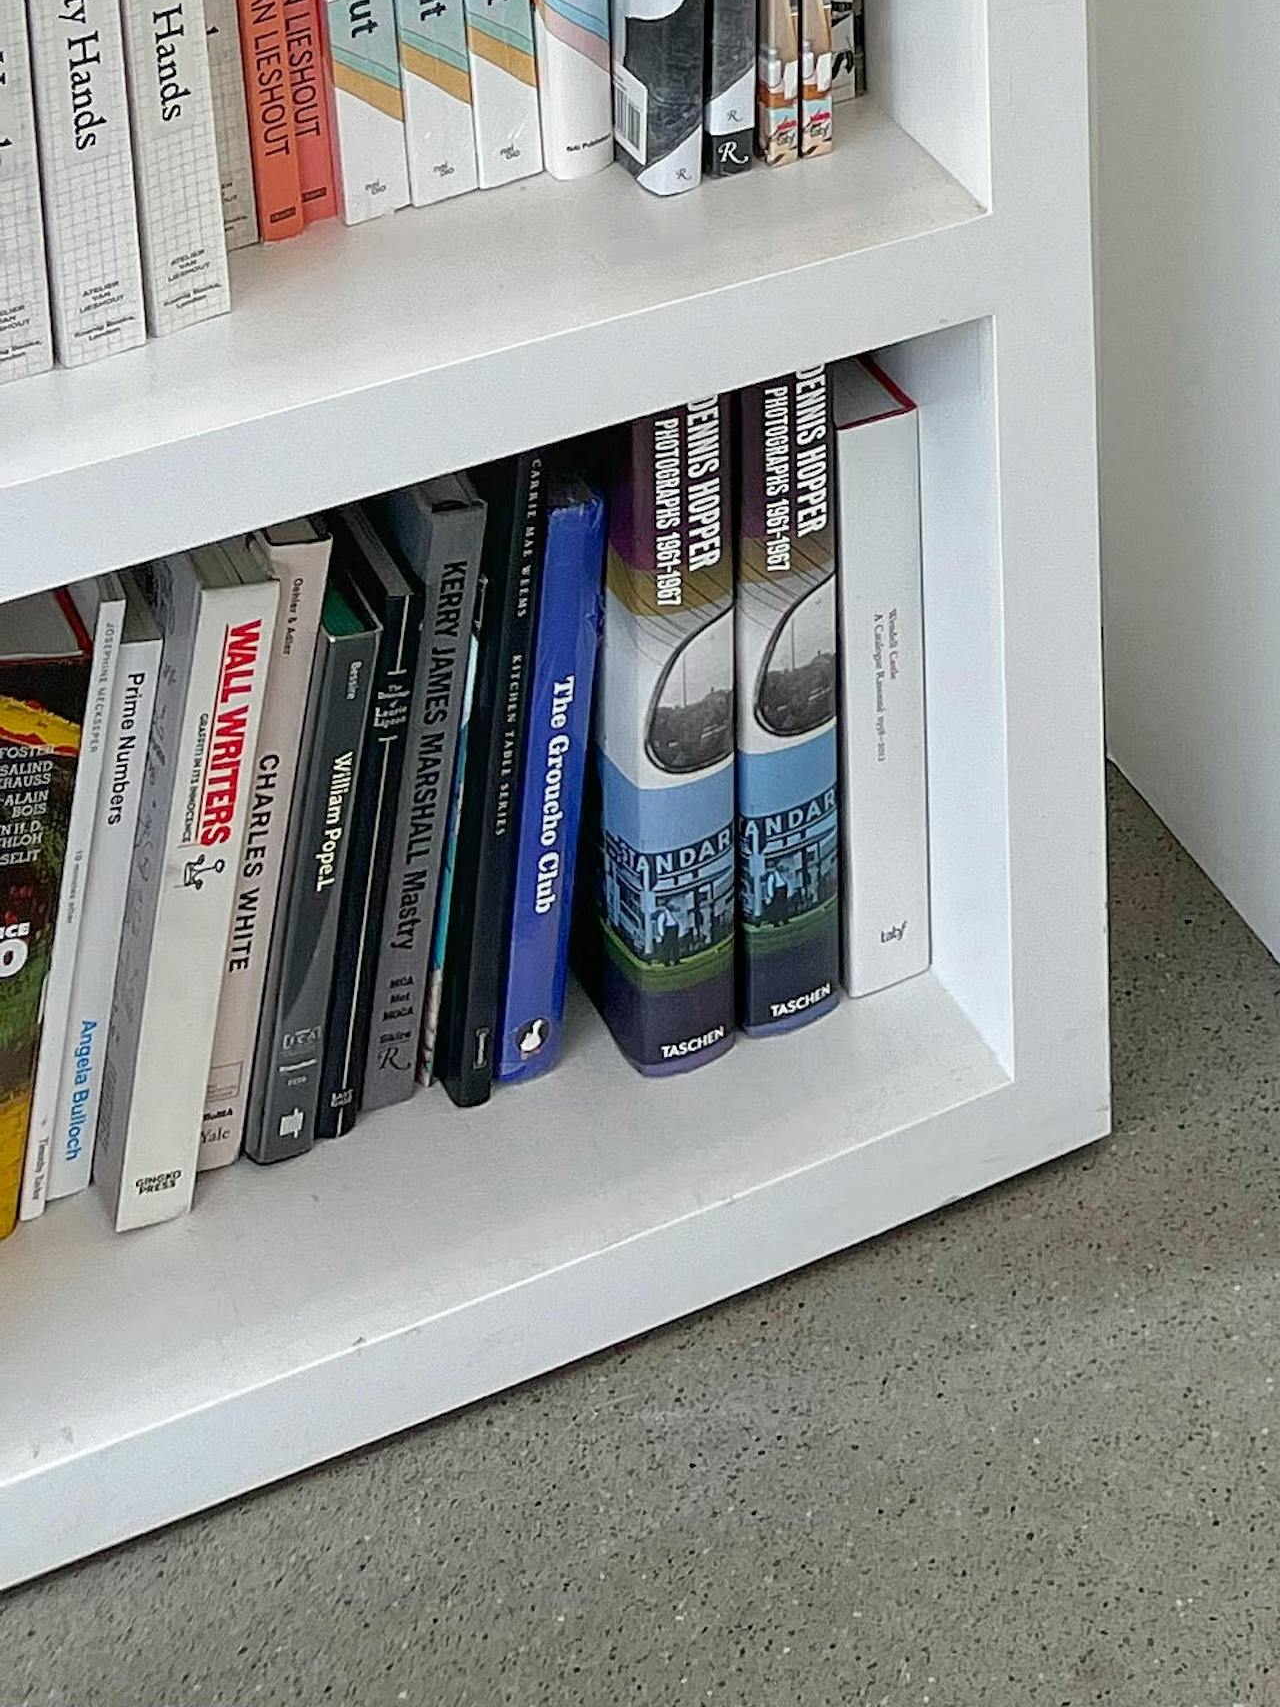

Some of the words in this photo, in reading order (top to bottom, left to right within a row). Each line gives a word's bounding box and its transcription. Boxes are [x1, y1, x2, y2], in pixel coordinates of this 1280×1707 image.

[68, 31, 107, 150] Hands
[153, 4, 191, 122] Hands
[253, 30, 290, 156] LIESHOUT
[285, 11, 320, 137] LIESHOUT
[687, 394, 720, 479] DENNIS
[764, 386, 789, 497] PHOTOGRAPHS
[795, 365, 826, 446] DENNIS
[527, 458, 542, 519] CARRIE
[654, 417, 681, 530] PHOTOGRAPHS
[797, 444, 827, 538] HOPPER
[523, 526, 535, 557] MAE
[688, 477, 721, 572] HOPPER
[766, 498, 790, 572] 1961-1967
[434, 559, 468, 638] KERRY
[517, 563, 531, 619] WEEMS
[656, 532, 682, 606] 1961-1967
[220, 619, 262, 703] WALL
[424, 646, 456, 726] JAMES
[507, 654, 523, 723] KITCHEN
[121, 672, 145, 731] Prime
[550, 674, 575, 729] The
[0, 760, 53, 777] SALIND
[0, 773, 51, 789] RAUSS
[108, 737, 135, 826] Numbers
[200, 704, 250, 847] WRITERS
[326, 751, 354, 825] William
[501, 730, 516, 779] TABLE
[539, 735, 570, 848] Groucho
[11, 803, 47, 819] BOIS
[243, 754, 280, 878] CHARLES
[405, 732, 444, 866] MARSHALL
[495, 784, 511, 837] SERIES
[0, 834, 43, 849] HLOH
[0, 849, 41, 866] SELIT
[315, 827, 342, 893] Pope.L
[390, 868, 428, 950] Mastry
[534, 852, 561, 915] Club
[228, 887, 260, 973] WHITE
[770, 983, 831, 1018] TASCHEN
[74, 1020, 98, 1085] Angela
[660, 1026, 726, 1059] TASCHEN
[65, 1088, 91, 1162] Bulloch
